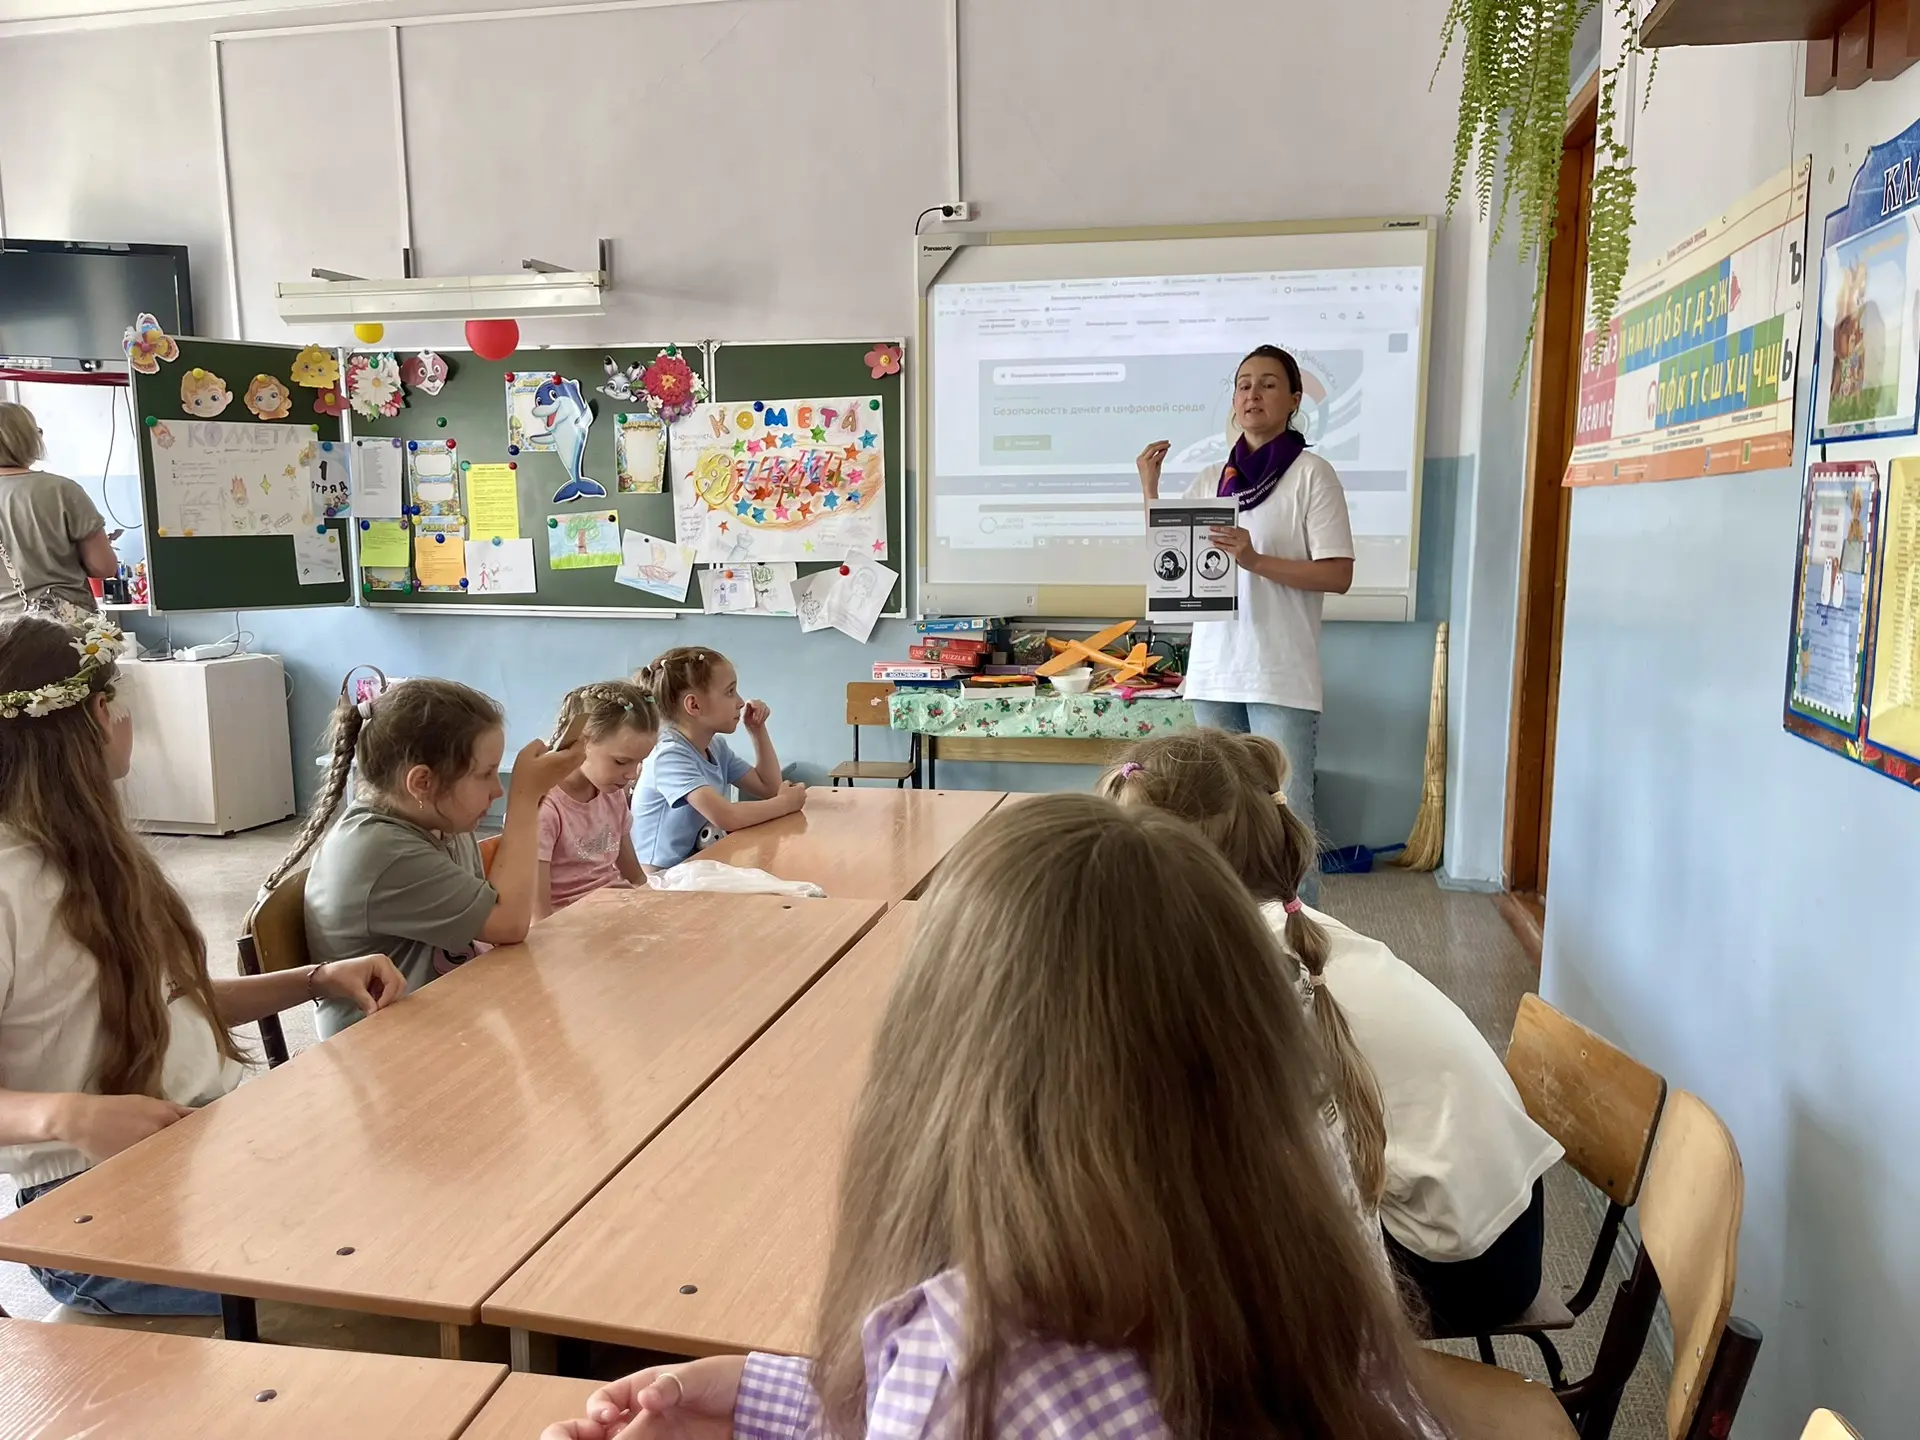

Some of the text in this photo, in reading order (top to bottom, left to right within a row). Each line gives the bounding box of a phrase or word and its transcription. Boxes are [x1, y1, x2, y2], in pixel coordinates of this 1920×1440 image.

[993, 406, 1068, 416] Безопасность
[1069, 405, 1102, 416] денег
[1112, 403, 1170, 415] цифровой
[1172, 402, 1206, 414] среде
[709, 406, 859, 438] КОМЕТА
[187, 421, 300, 448] КОМЕТА
[319, 460, 328, 481] 1
[311, 480, 349, 495] ОТРЯД
[941, 653, 966, 661] PUZZLE
